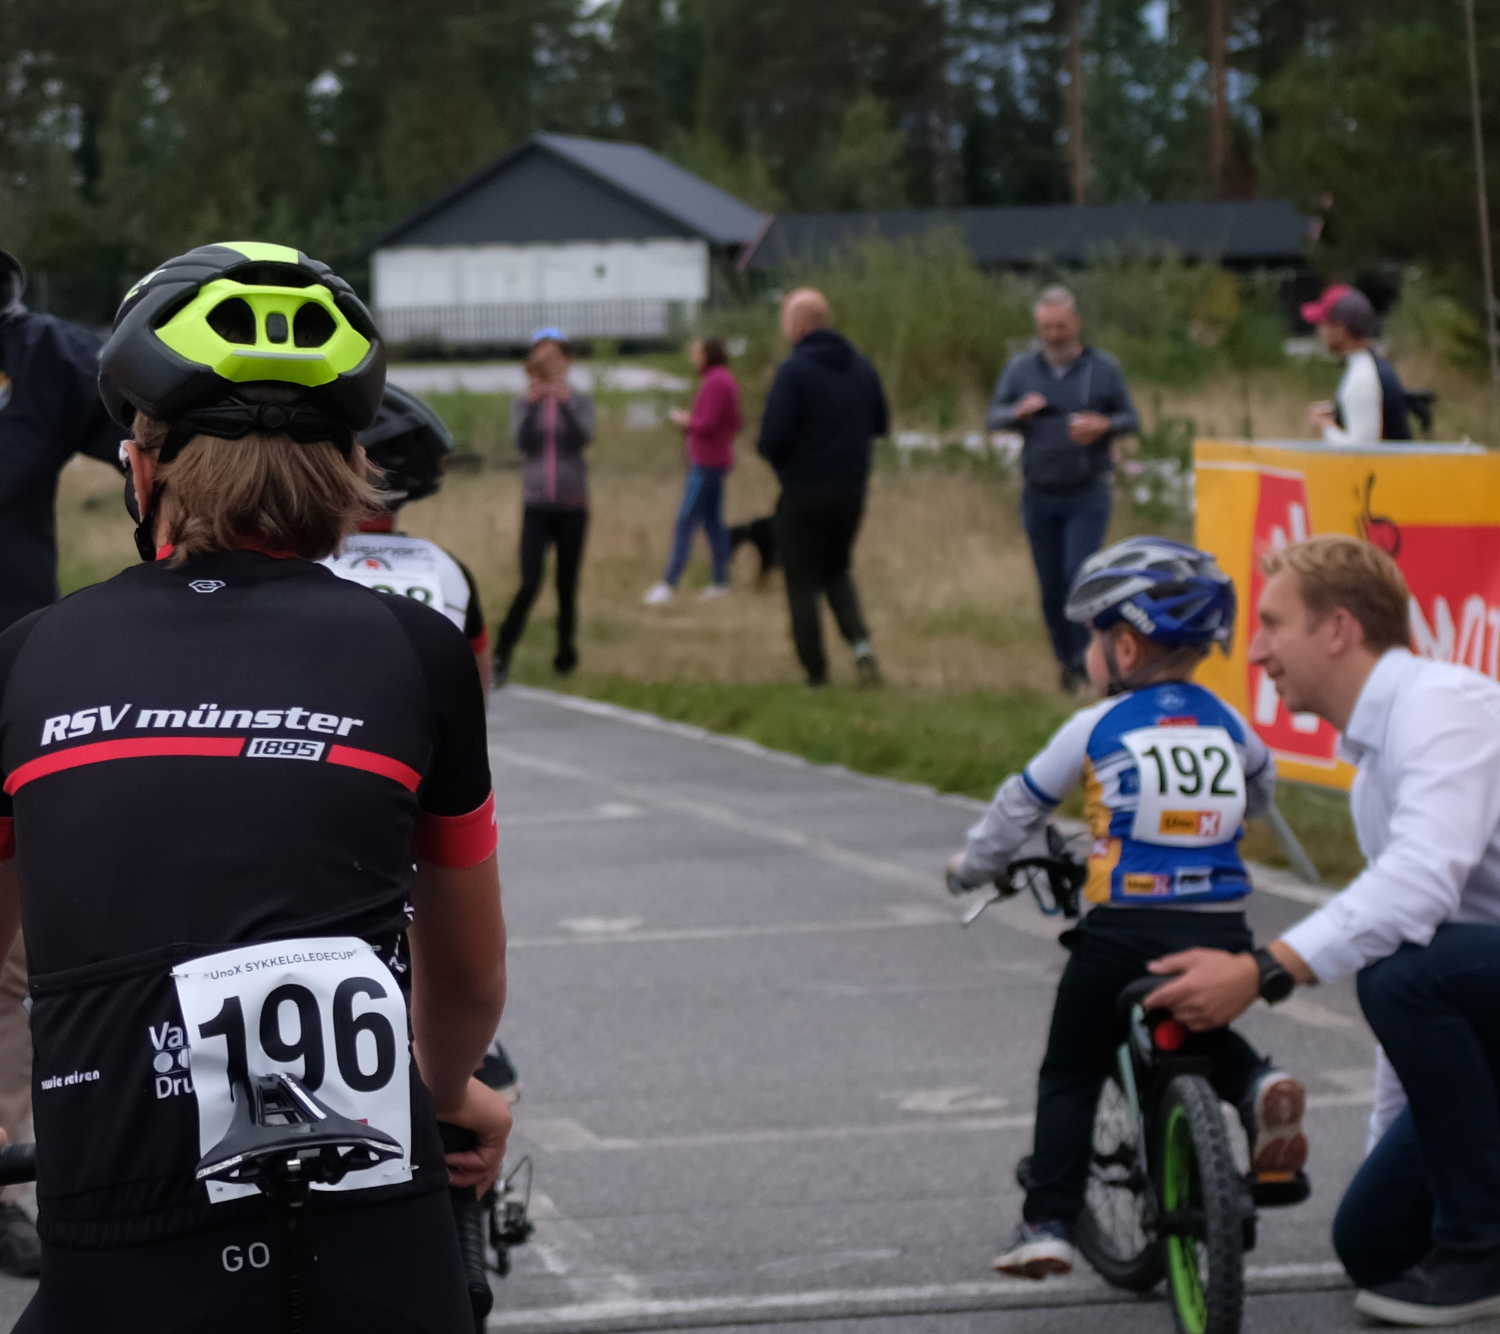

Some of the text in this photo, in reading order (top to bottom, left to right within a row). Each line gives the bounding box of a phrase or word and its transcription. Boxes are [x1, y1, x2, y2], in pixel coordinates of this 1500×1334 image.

[40, 703, 365, 747] RSV münster
[252, 739, 316, 758] 1895
[1141, 744, 1239, 798] 192
[1199, 811, 1220, 837] X
[210, 950, 354, 981] UnoX SYKKELGLEDECUP
[197, 976, 397, 1103] 196
